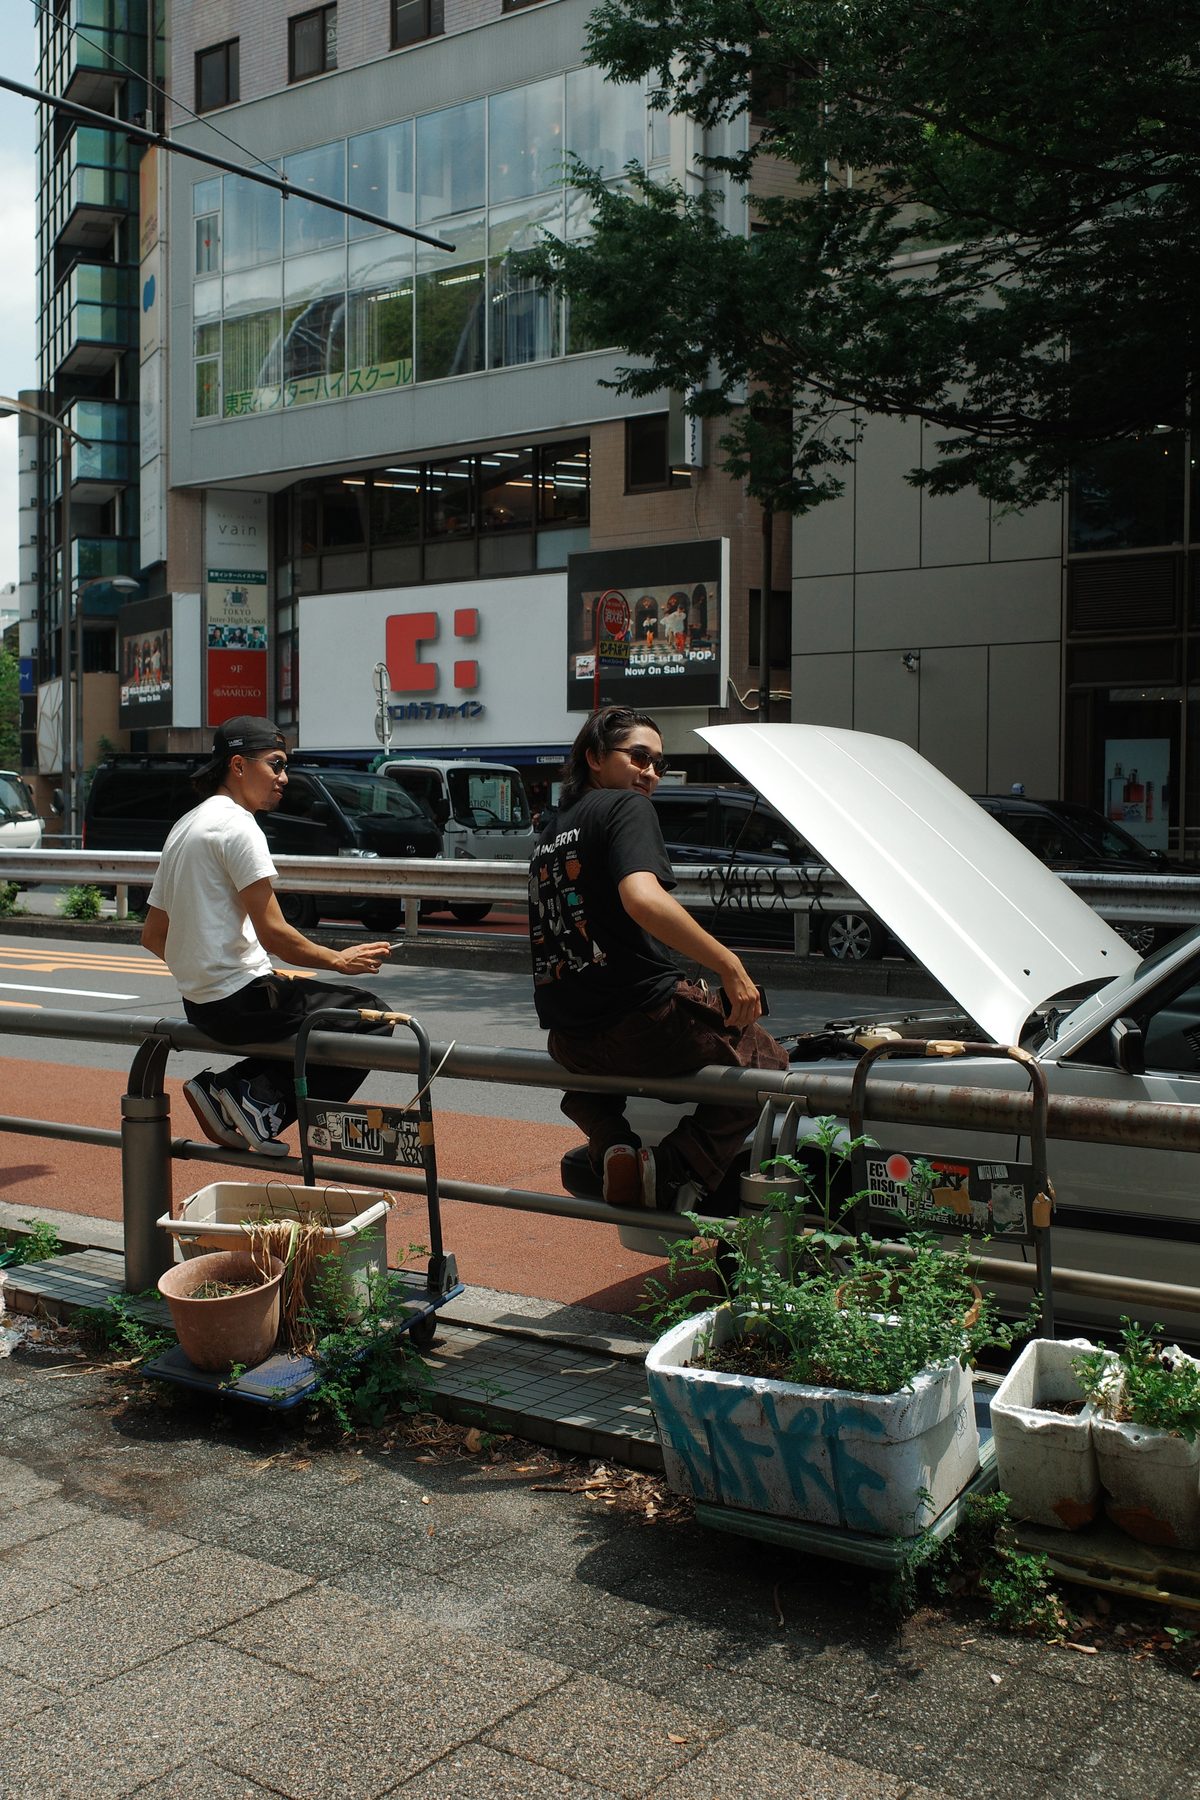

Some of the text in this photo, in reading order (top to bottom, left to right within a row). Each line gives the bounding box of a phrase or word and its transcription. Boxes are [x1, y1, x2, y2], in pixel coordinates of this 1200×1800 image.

[218, 524, 257, 536] vain
[223, 607, 251, 616] TOKYO
[230, 664, 243, 673] 9F
[624, 664, 685, 676] Now On Sale
[221, 688, 261, 698] MARUKO
